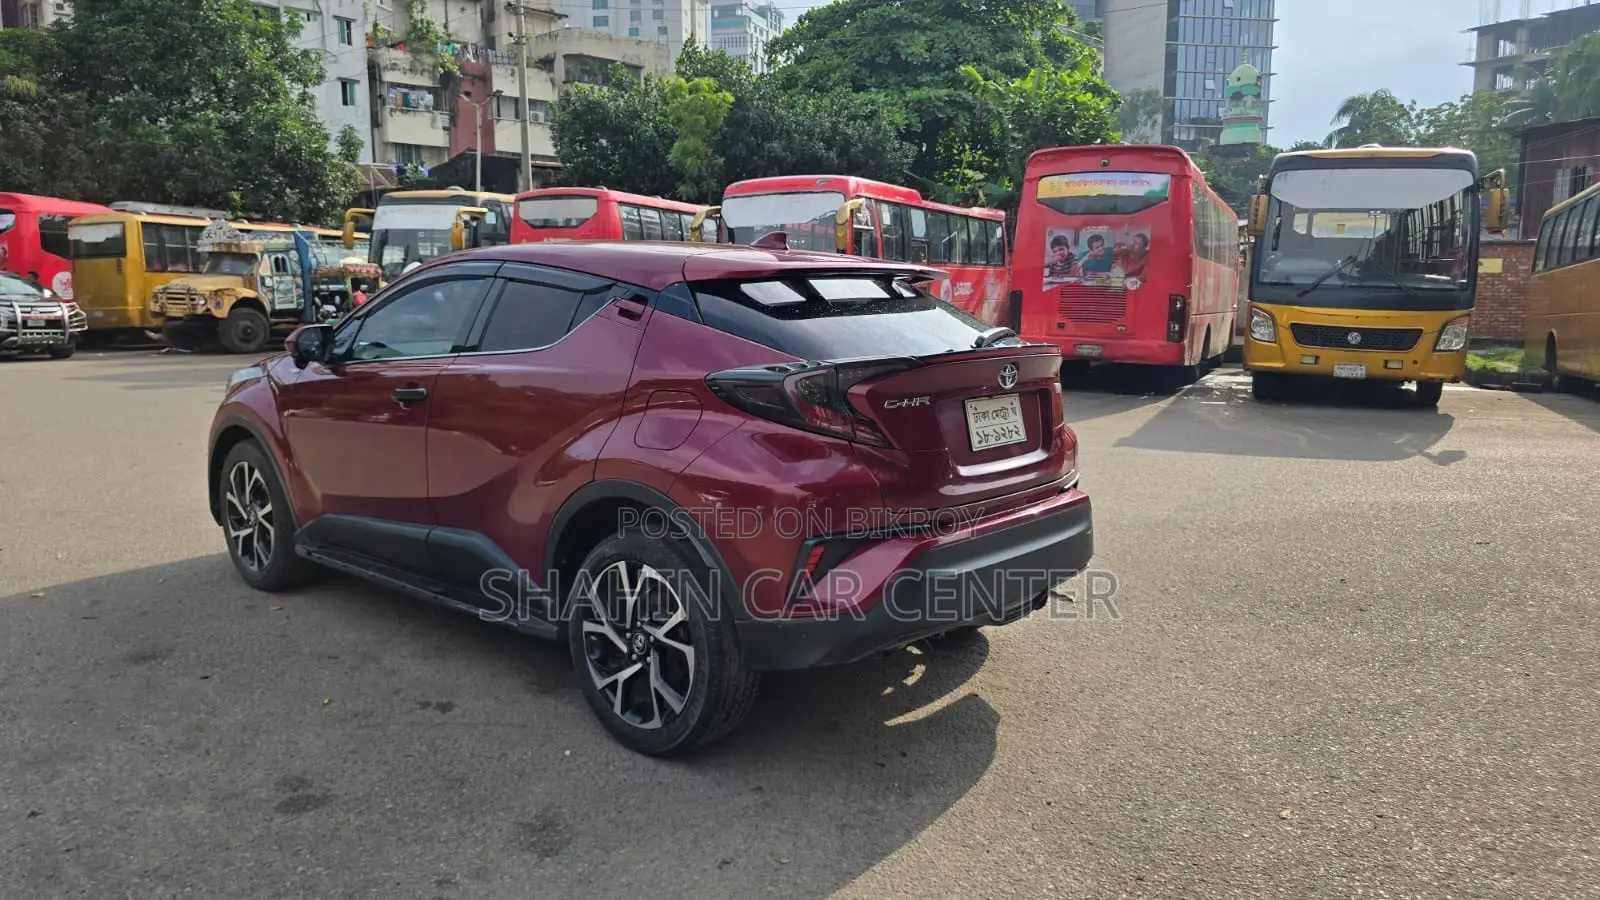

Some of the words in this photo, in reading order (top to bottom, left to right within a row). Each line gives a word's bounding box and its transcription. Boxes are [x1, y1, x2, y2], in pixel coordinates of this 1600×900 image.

[884, 396, 931, 409] C-HR
[972, 410, 990, 424] ঢাকা
[975, 425, 1022, 445] ১৮-১২৮২
